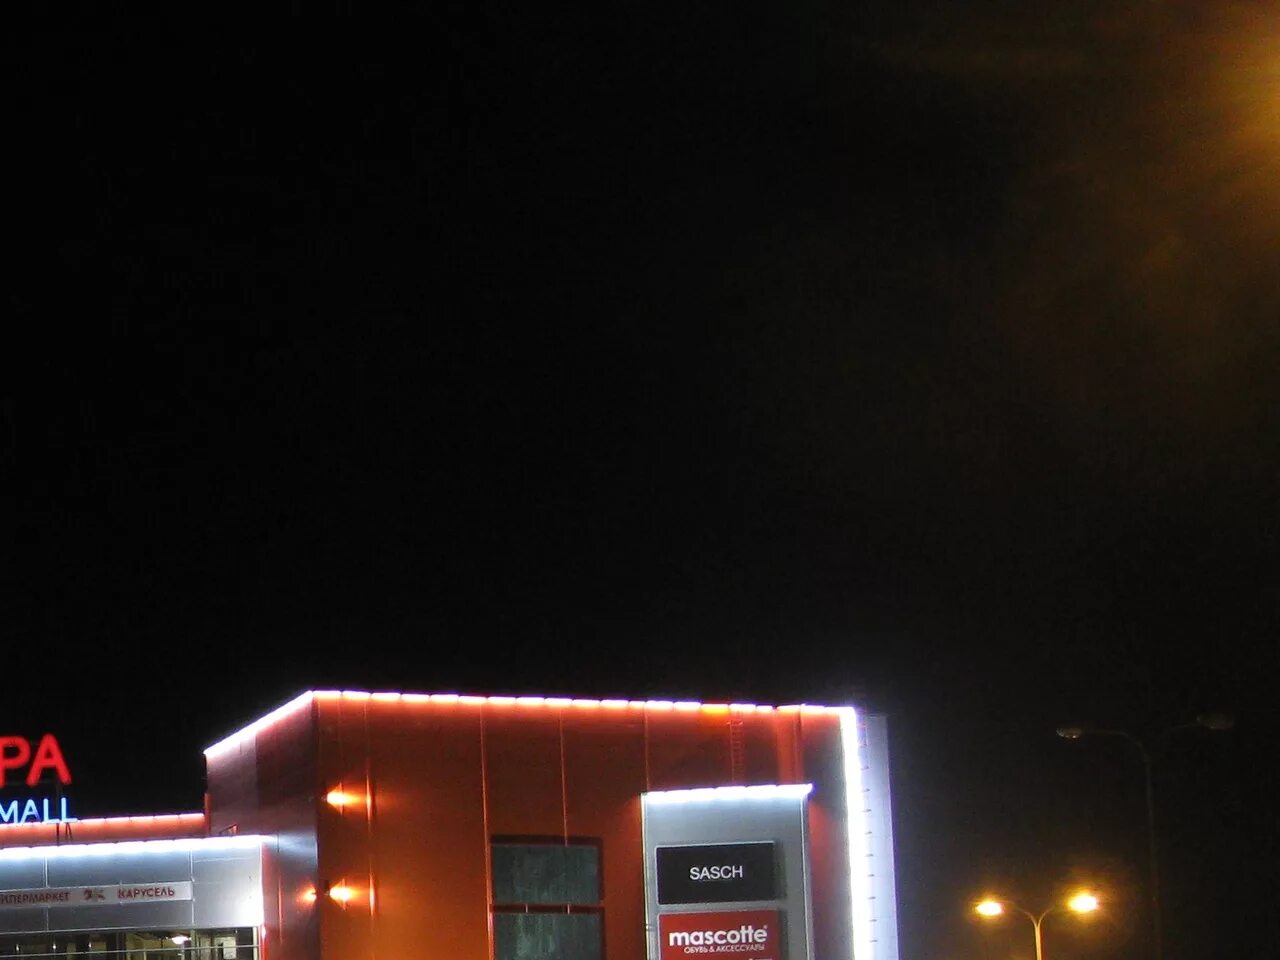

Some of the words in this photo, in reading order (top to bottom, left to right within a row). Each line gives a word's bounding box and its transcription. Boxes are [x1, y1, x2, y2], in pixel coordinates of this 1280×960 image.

[689, 865, 743, 880] SASCH
[117, 887, 176, 899] КАРУСЕЛЬ
[669, 925, 768, 947] mascotte
